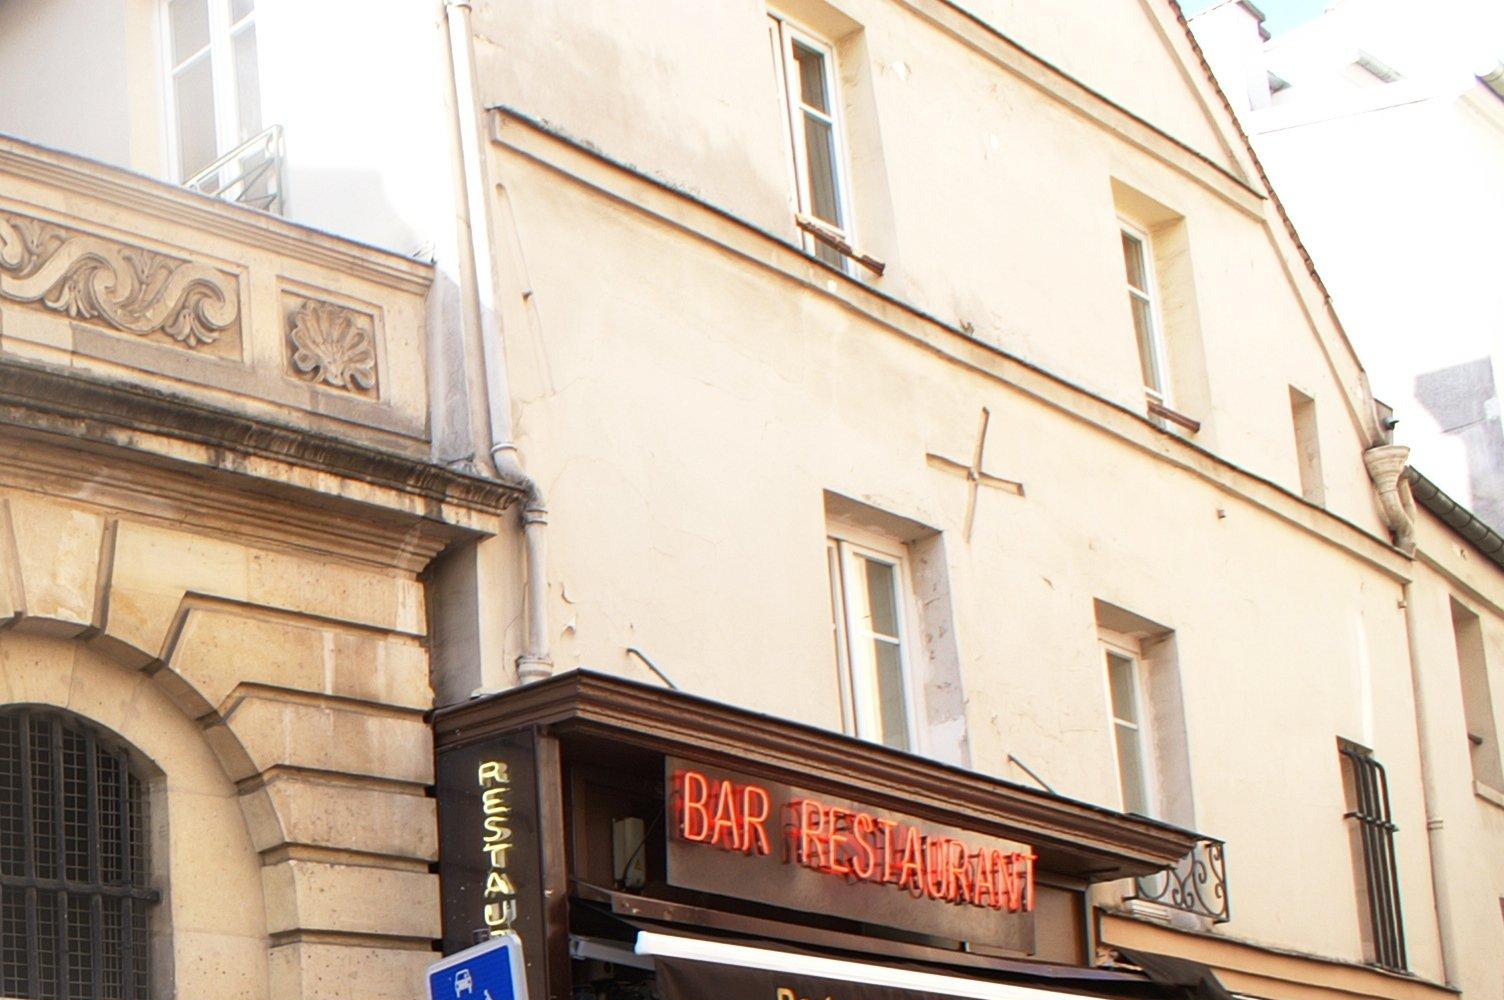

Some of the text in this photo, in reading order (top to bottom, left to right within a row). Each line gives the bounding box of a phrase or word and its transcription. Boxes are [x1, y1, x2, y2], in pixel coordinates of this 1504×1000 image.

[478, 761, 517, 937] RESTAU
[682, 771, 1039, 913] BAR RESTAURANT
